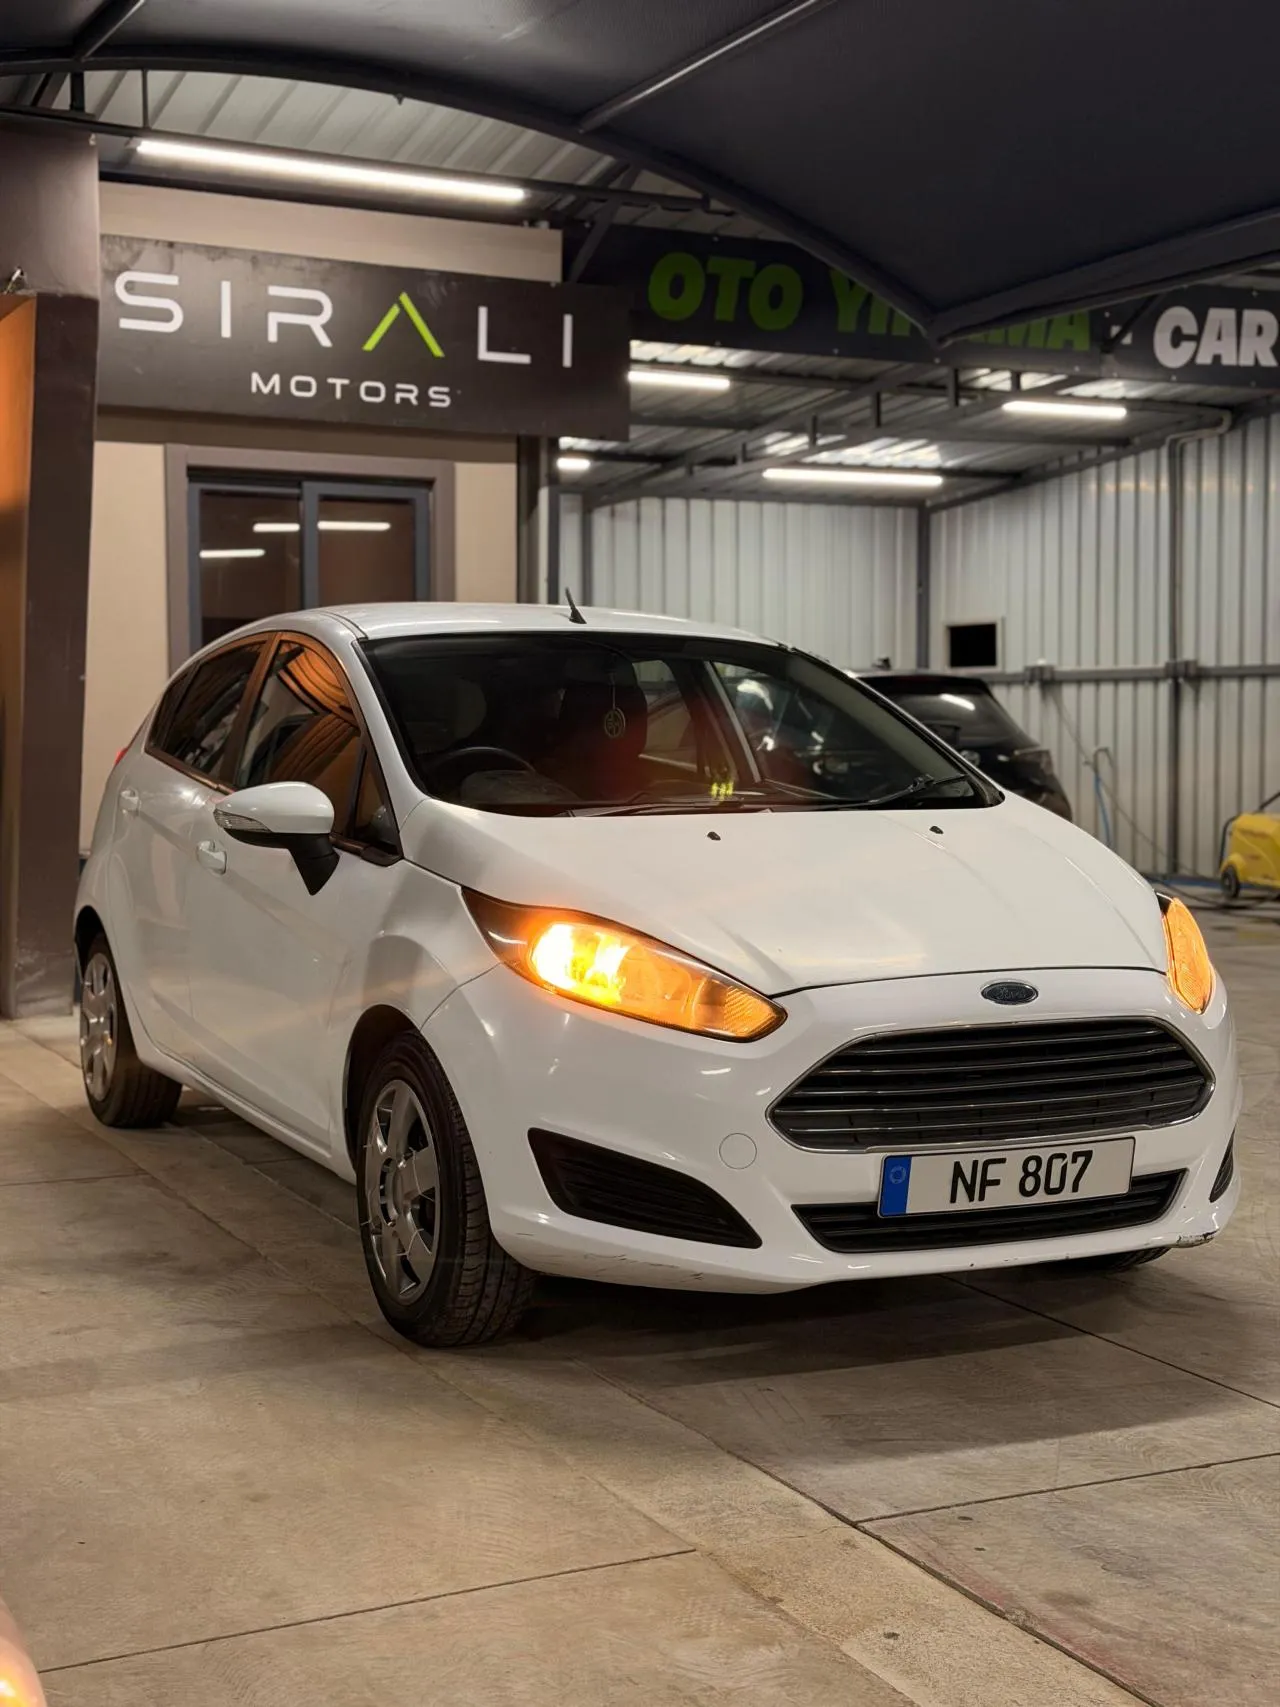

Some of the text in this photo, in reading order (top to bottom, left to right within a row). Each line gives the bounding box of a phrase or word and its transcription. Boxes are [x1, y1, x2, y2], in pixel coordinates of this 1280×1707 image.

[114, 270, 573, 368] SIRALI
[647, 252, 804, 331] OTO
[1153, 306, 1279, 368] CAR
[251, 372, 451, 408] MOTORS
[949, 1149, 1094, 1204] NF 807
